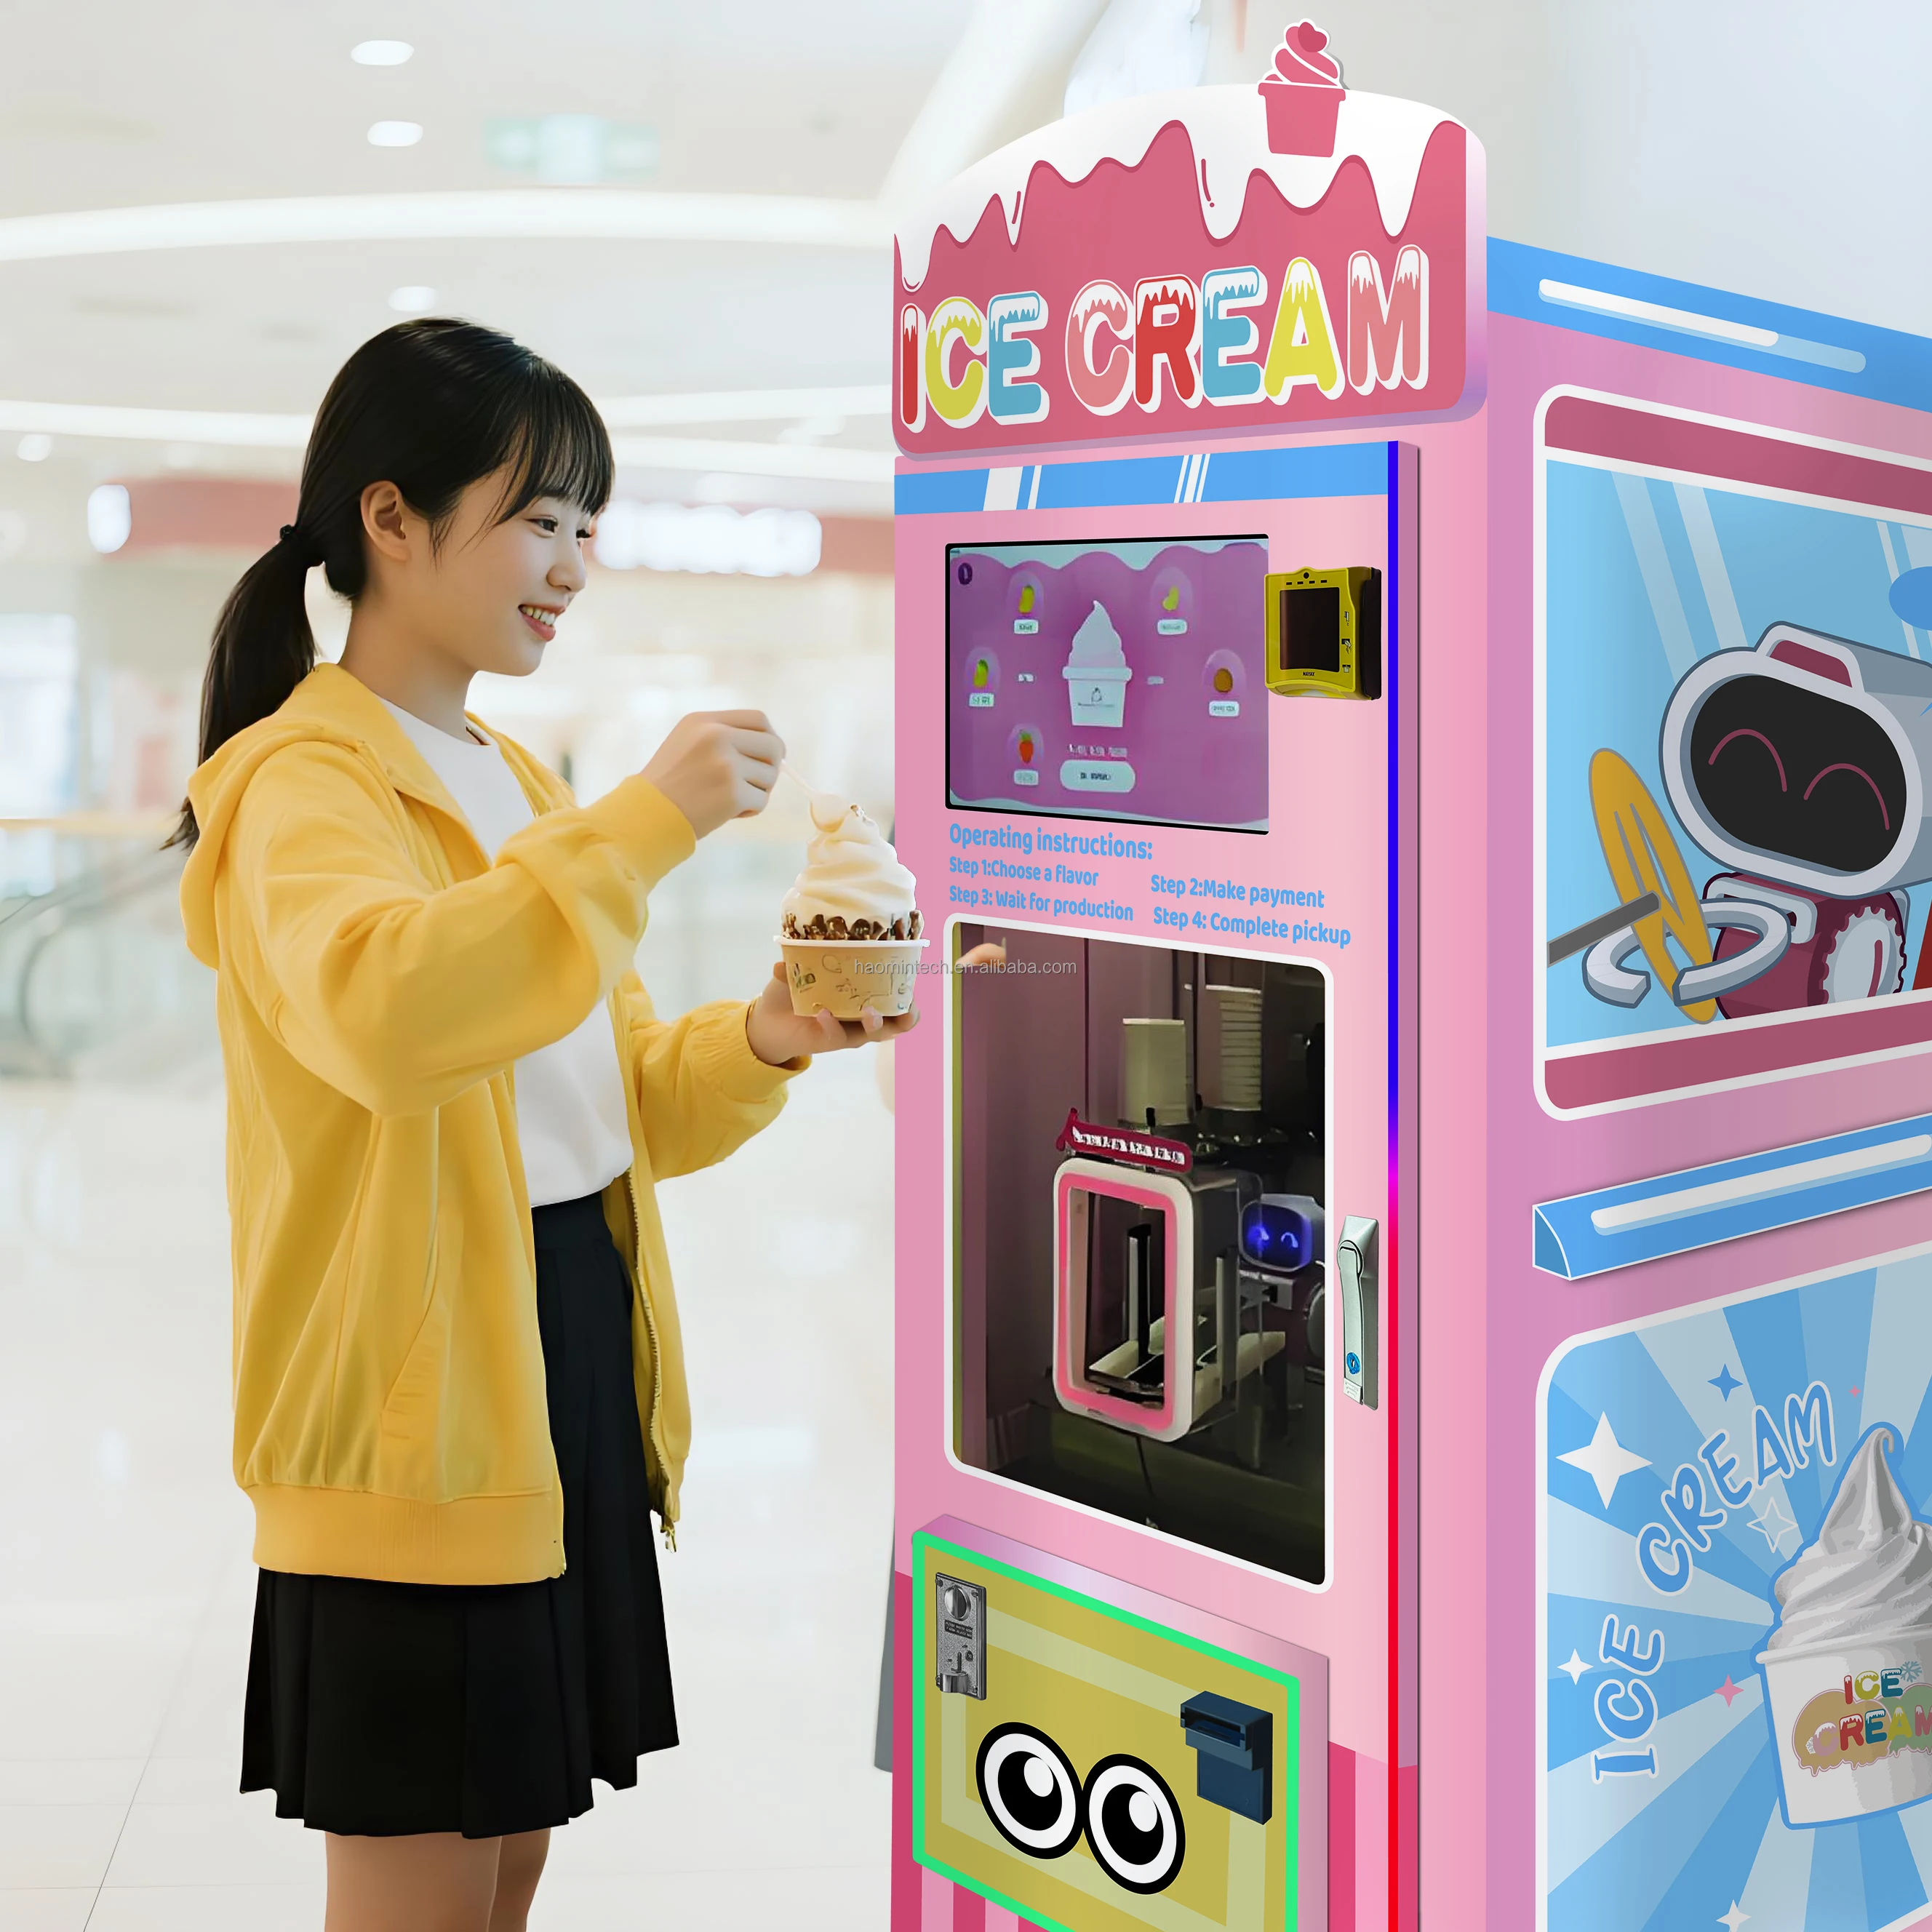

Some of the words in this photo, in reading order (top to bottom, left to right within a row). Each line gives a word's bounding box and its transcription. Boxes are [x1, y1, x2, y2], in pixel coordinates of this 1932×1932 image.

[900, 291, 1050, 433] ICE
[1064, 244, 1429, 416] CREAM
[949, 823, 1033, 855] Operating
[1037, 826, 1153, 861] instructions:
[949, 856, 979, 878] Step
[981, 859, 1041, 881] 1:Choose
[1044, 868, 1053, 882] a
[1055, 863, 1099, 886] flavor
[949, 885, 979, 908] Step
[981, 888, 993, 906] 3:
[995, 890, 1026, 910] Wait
[1029, 892, 1051, 911] for
[1053, 898, 1134, 922] production
[1151, 874, 1186, 899] Step
[1189, 877, 1246, 901] 2:Make
[1249, 886, 1325, 909] payment
[1153, 906, 1189, 932] Step
[1191, 911, 1207, 930] 4:
[1210, 912, 1289, 939] Complete
[1293, 919, 1351, 949] pickup
[1591, 1613, 1666, 1784] ICE
[1636, 1381, 1837, 1595] CREAM
[1843, 1668, 1904, 1705] ICE
[1812, 1704, 1932, 1757] CREAM
